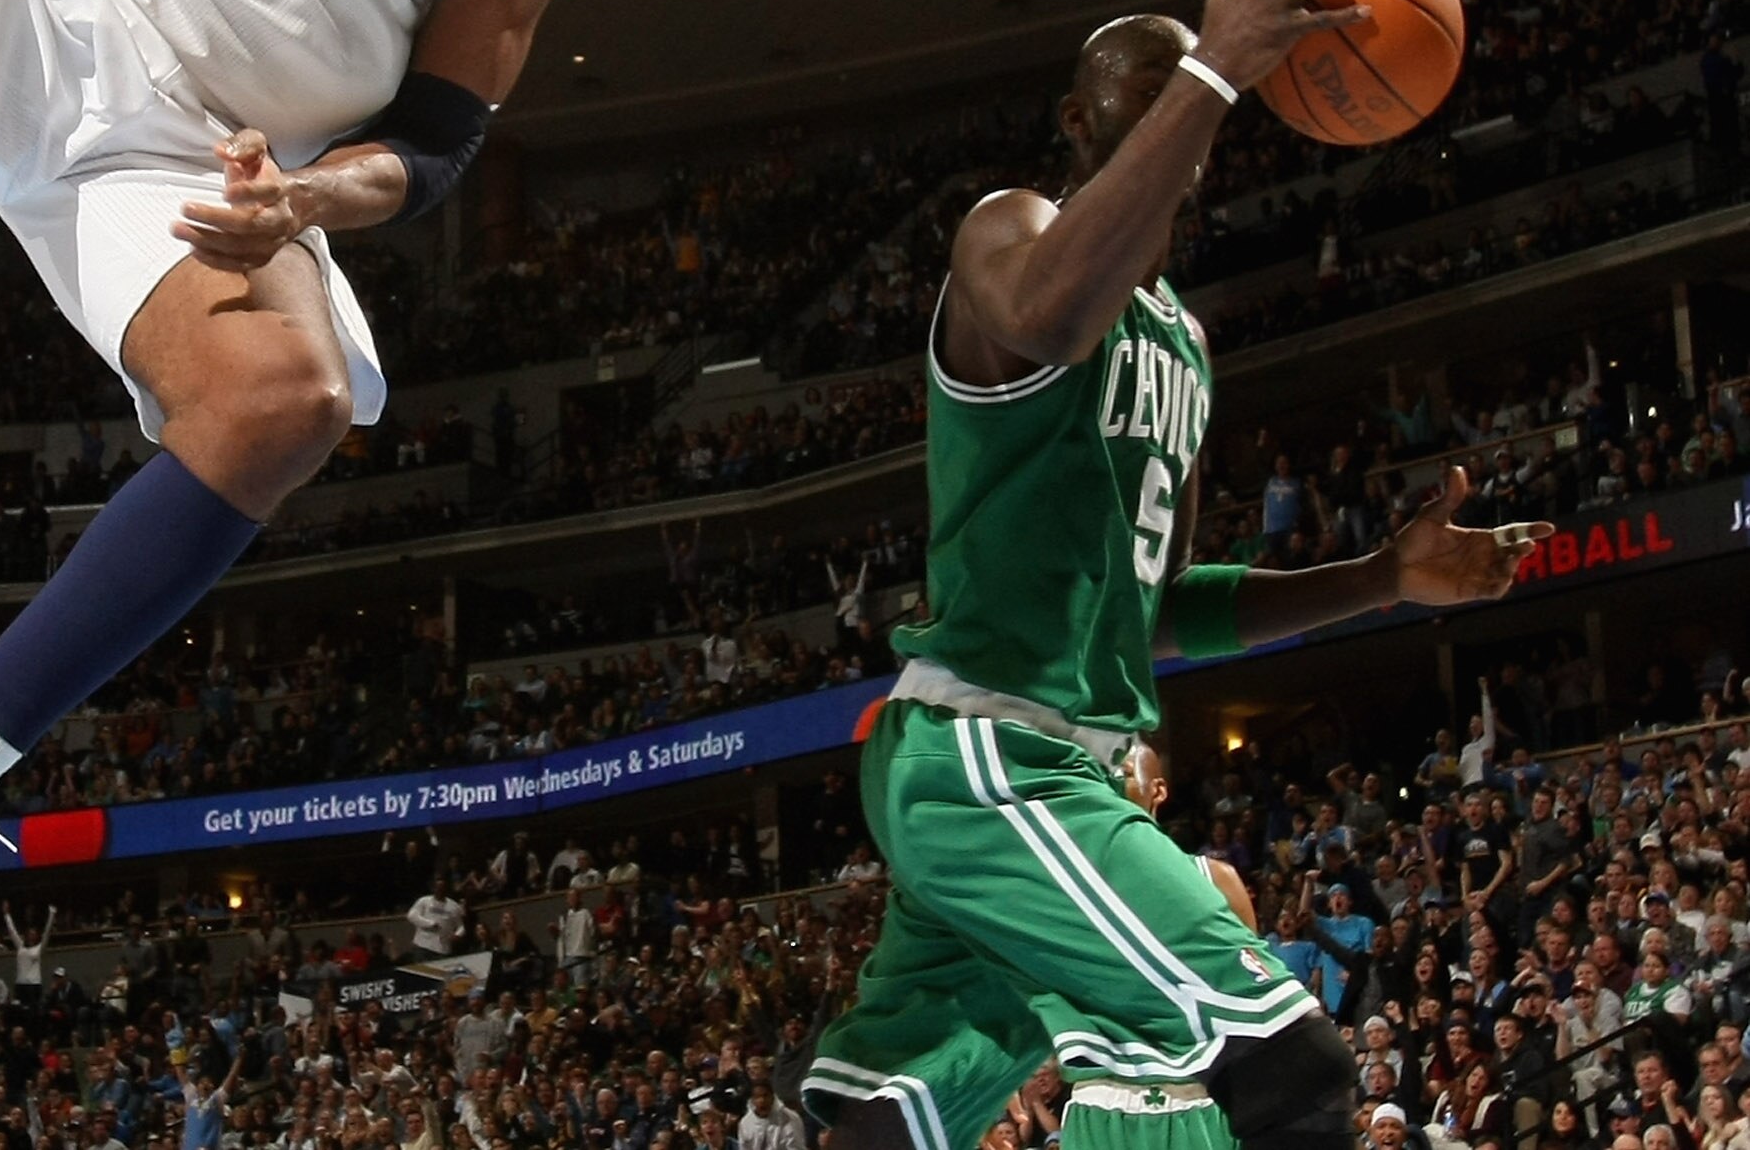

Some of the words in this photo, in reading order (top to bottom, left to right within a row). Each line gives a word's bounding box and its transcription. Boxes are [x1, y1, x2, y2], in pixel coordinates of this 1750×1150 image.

[1132, 454, 1175, 587] 5
[204, 806, 244, 833] Get
[248, 804, 298, 835] your
[302, 794, 378, 822] tickets
[384, 789, 412, 819] by
[418, 782, 497, 812] 7:30pm
[503, 756, 622, 800] Wednesdays
[627, 749, 644, 775] &
[648, 730, 745, 770] Saturdays
[339, 978, 396, 1003] SWISH'S
